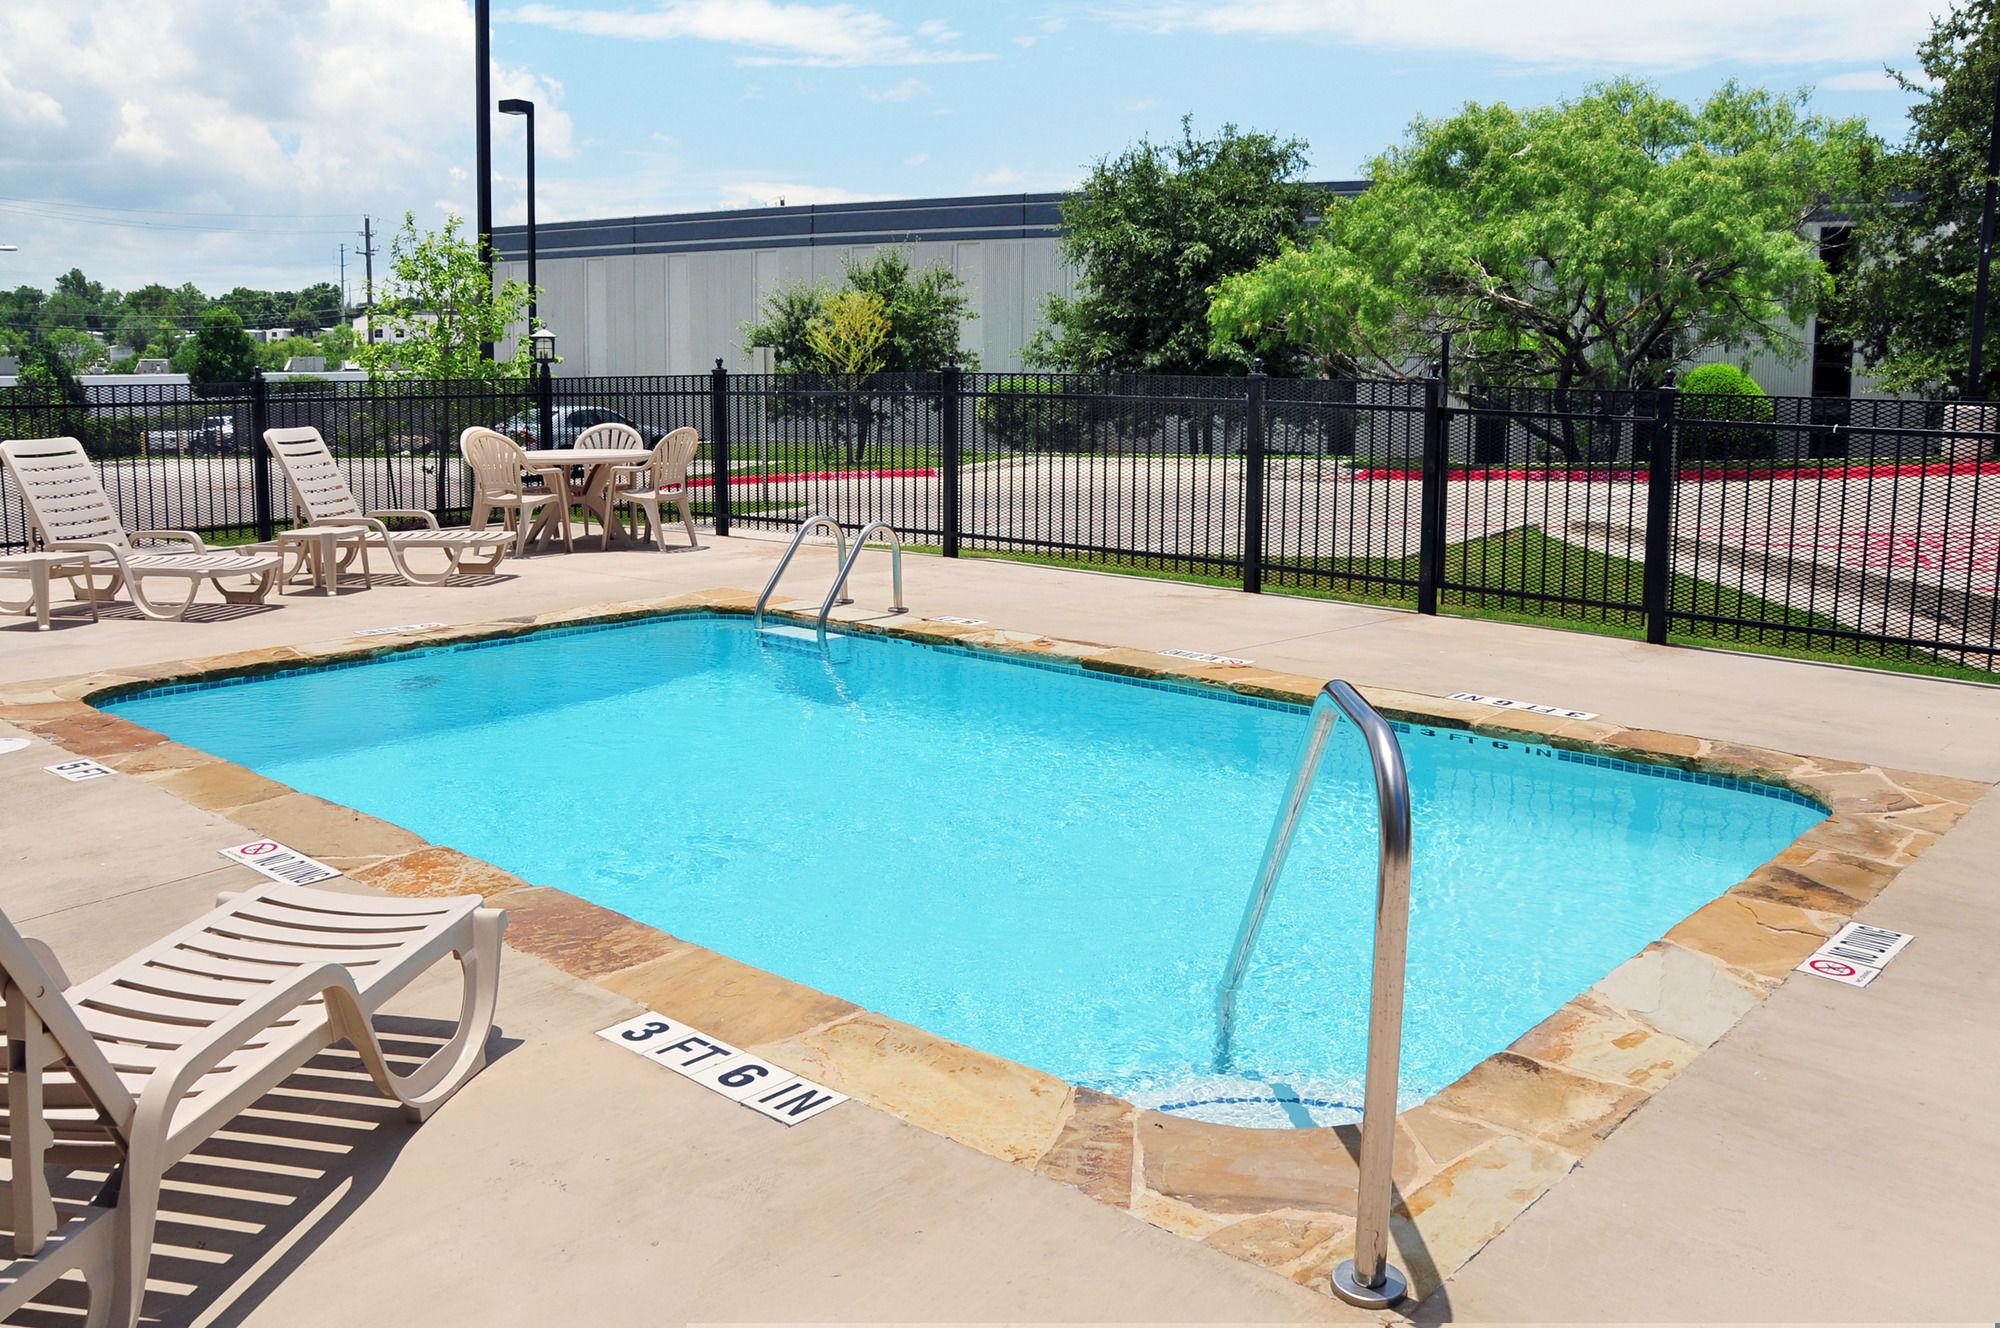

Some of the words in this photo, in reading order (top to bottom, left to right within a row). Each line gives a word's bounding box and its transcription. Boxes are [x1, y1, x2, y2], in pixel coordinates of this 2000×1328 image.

[1454, 692, 1485, 702] IN
[1491, 699, 1514, 707] 6
[1524, 703, 1557, 713] FT
[1564, 711, 1588, 719] 3
[1420, 728, 1436, 737] 3
[1448, 733, 1479, 745] FT
[1491, 741, 1509, 750] 6
[1524, 746, 1552, 758] IN
[56, 762, 91, 770] 5
[68, 768, 111, 779] FT
[251, 852, 297, 867] NO
[268, 859, 332, 884] DIVING
[1839, 925, 1903, 954] DIVING
[1827, 946, 1880, 965] NO
[620, 1021, 671, 1042] 3
[655, 1036, 733, 1067] FT
[717, 1063, 770, 1088] 6
[757, 1082, 834, 1117] IN
